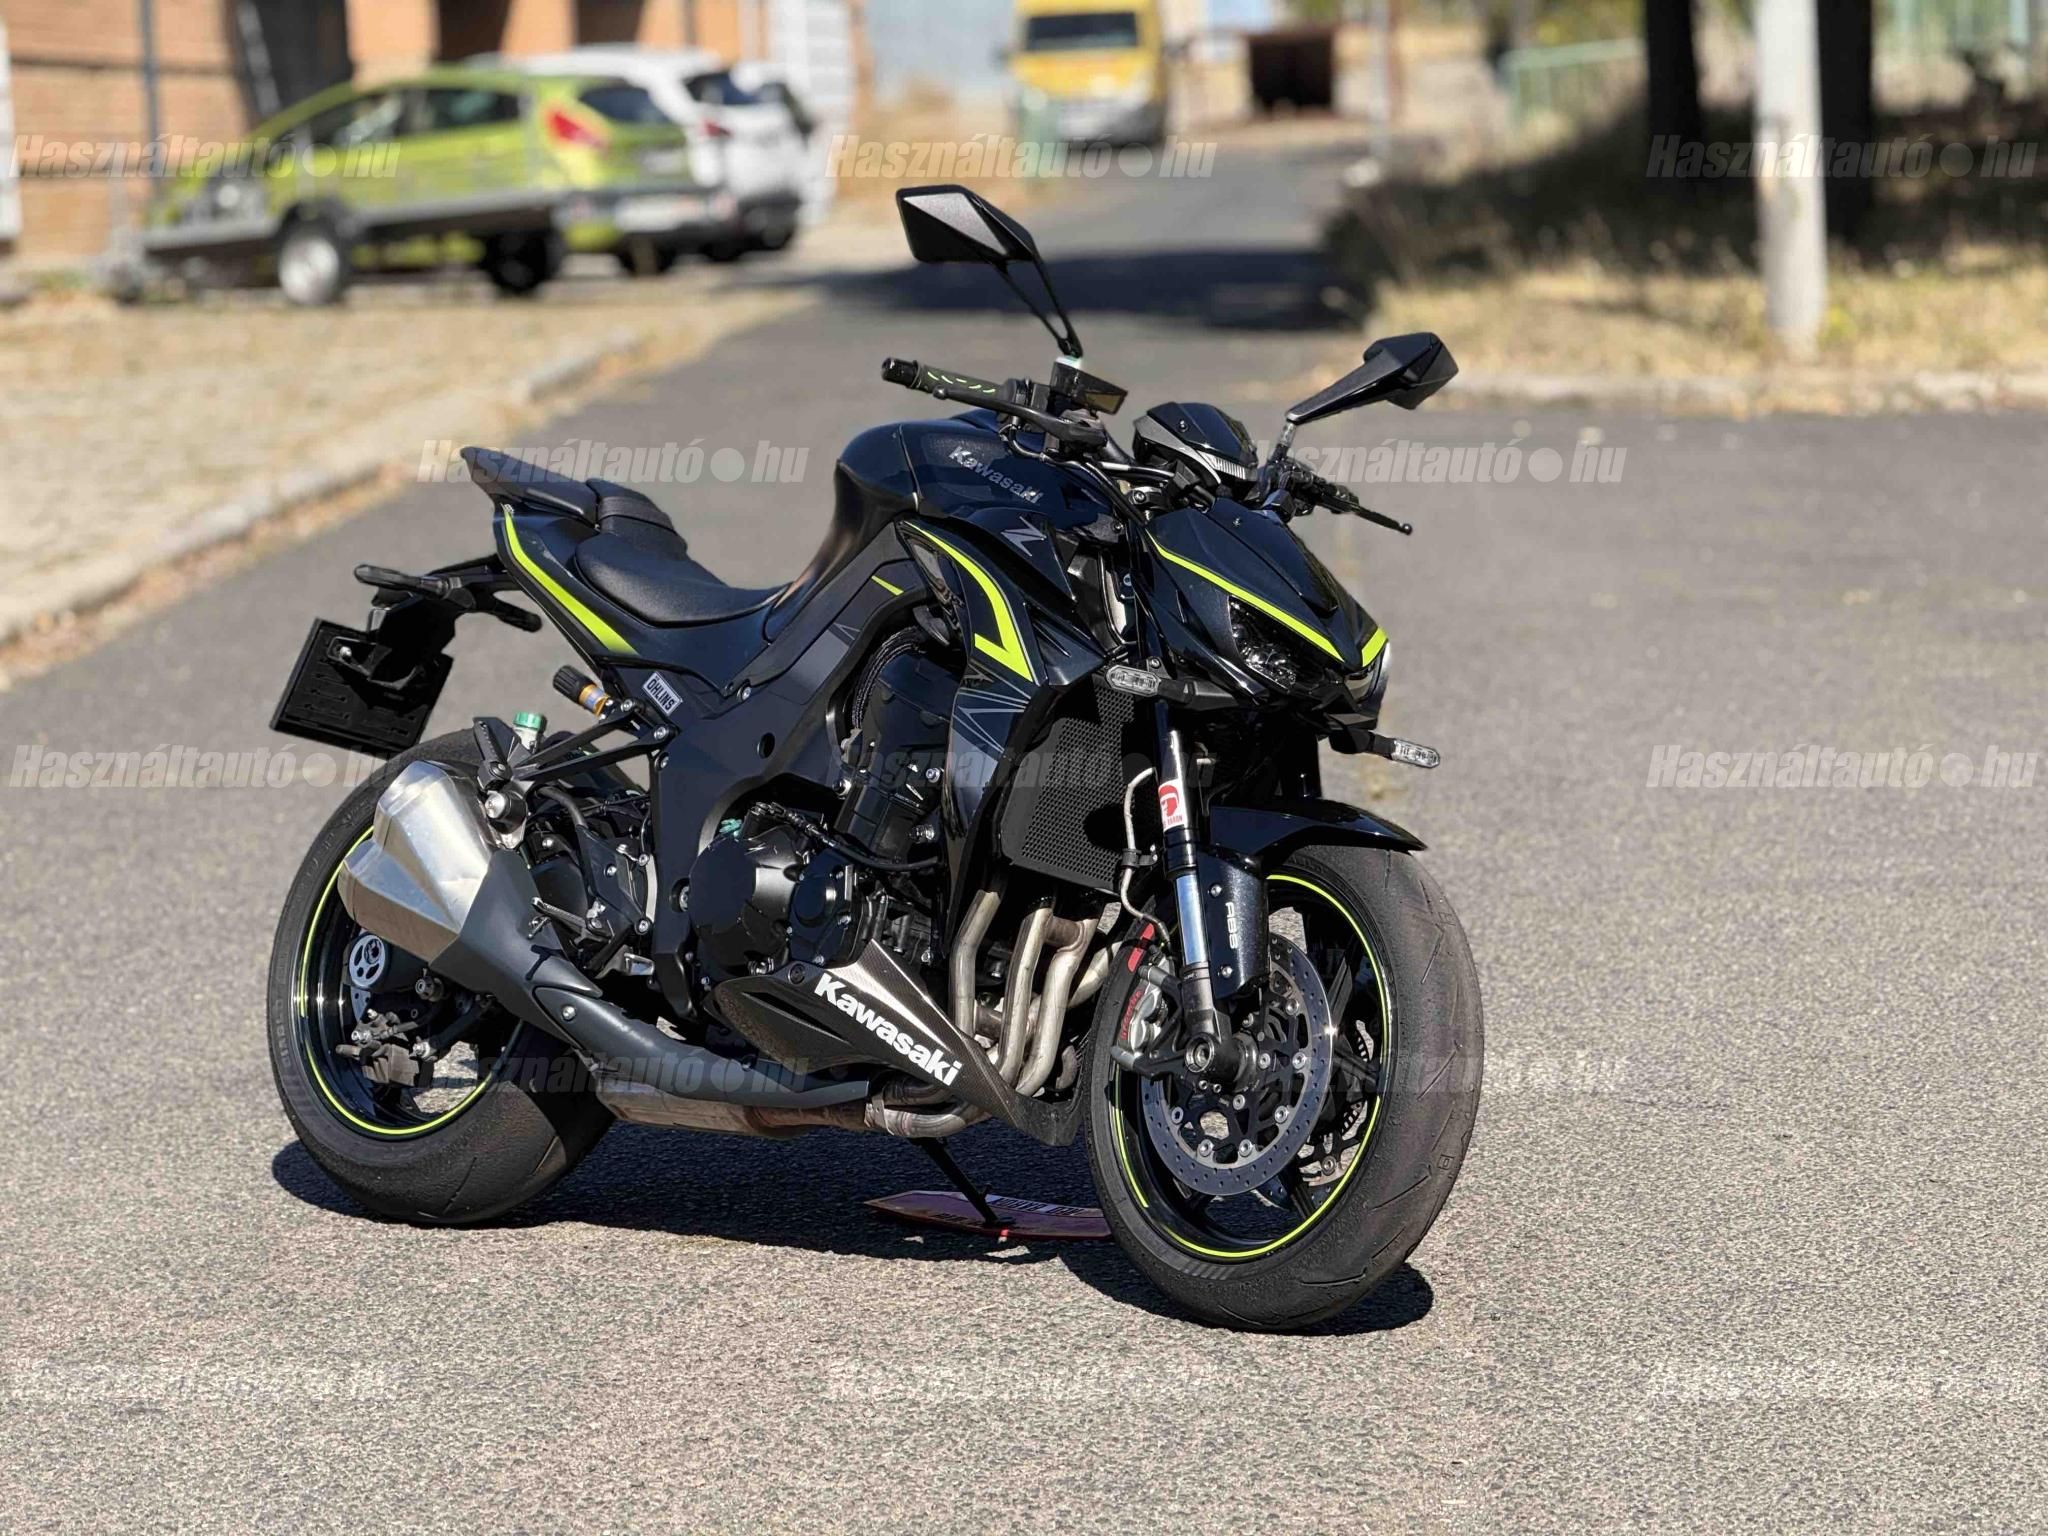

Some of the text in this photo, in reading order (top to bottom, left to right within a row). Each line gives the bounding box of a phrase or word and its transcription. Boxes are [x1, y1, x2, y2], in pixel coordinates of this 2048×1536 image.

[948, 446, 1044, 504] Kawasaki
[1225, 901, 1238, 950] ABS
[814, 973, 963, 1086] Kawasaki
